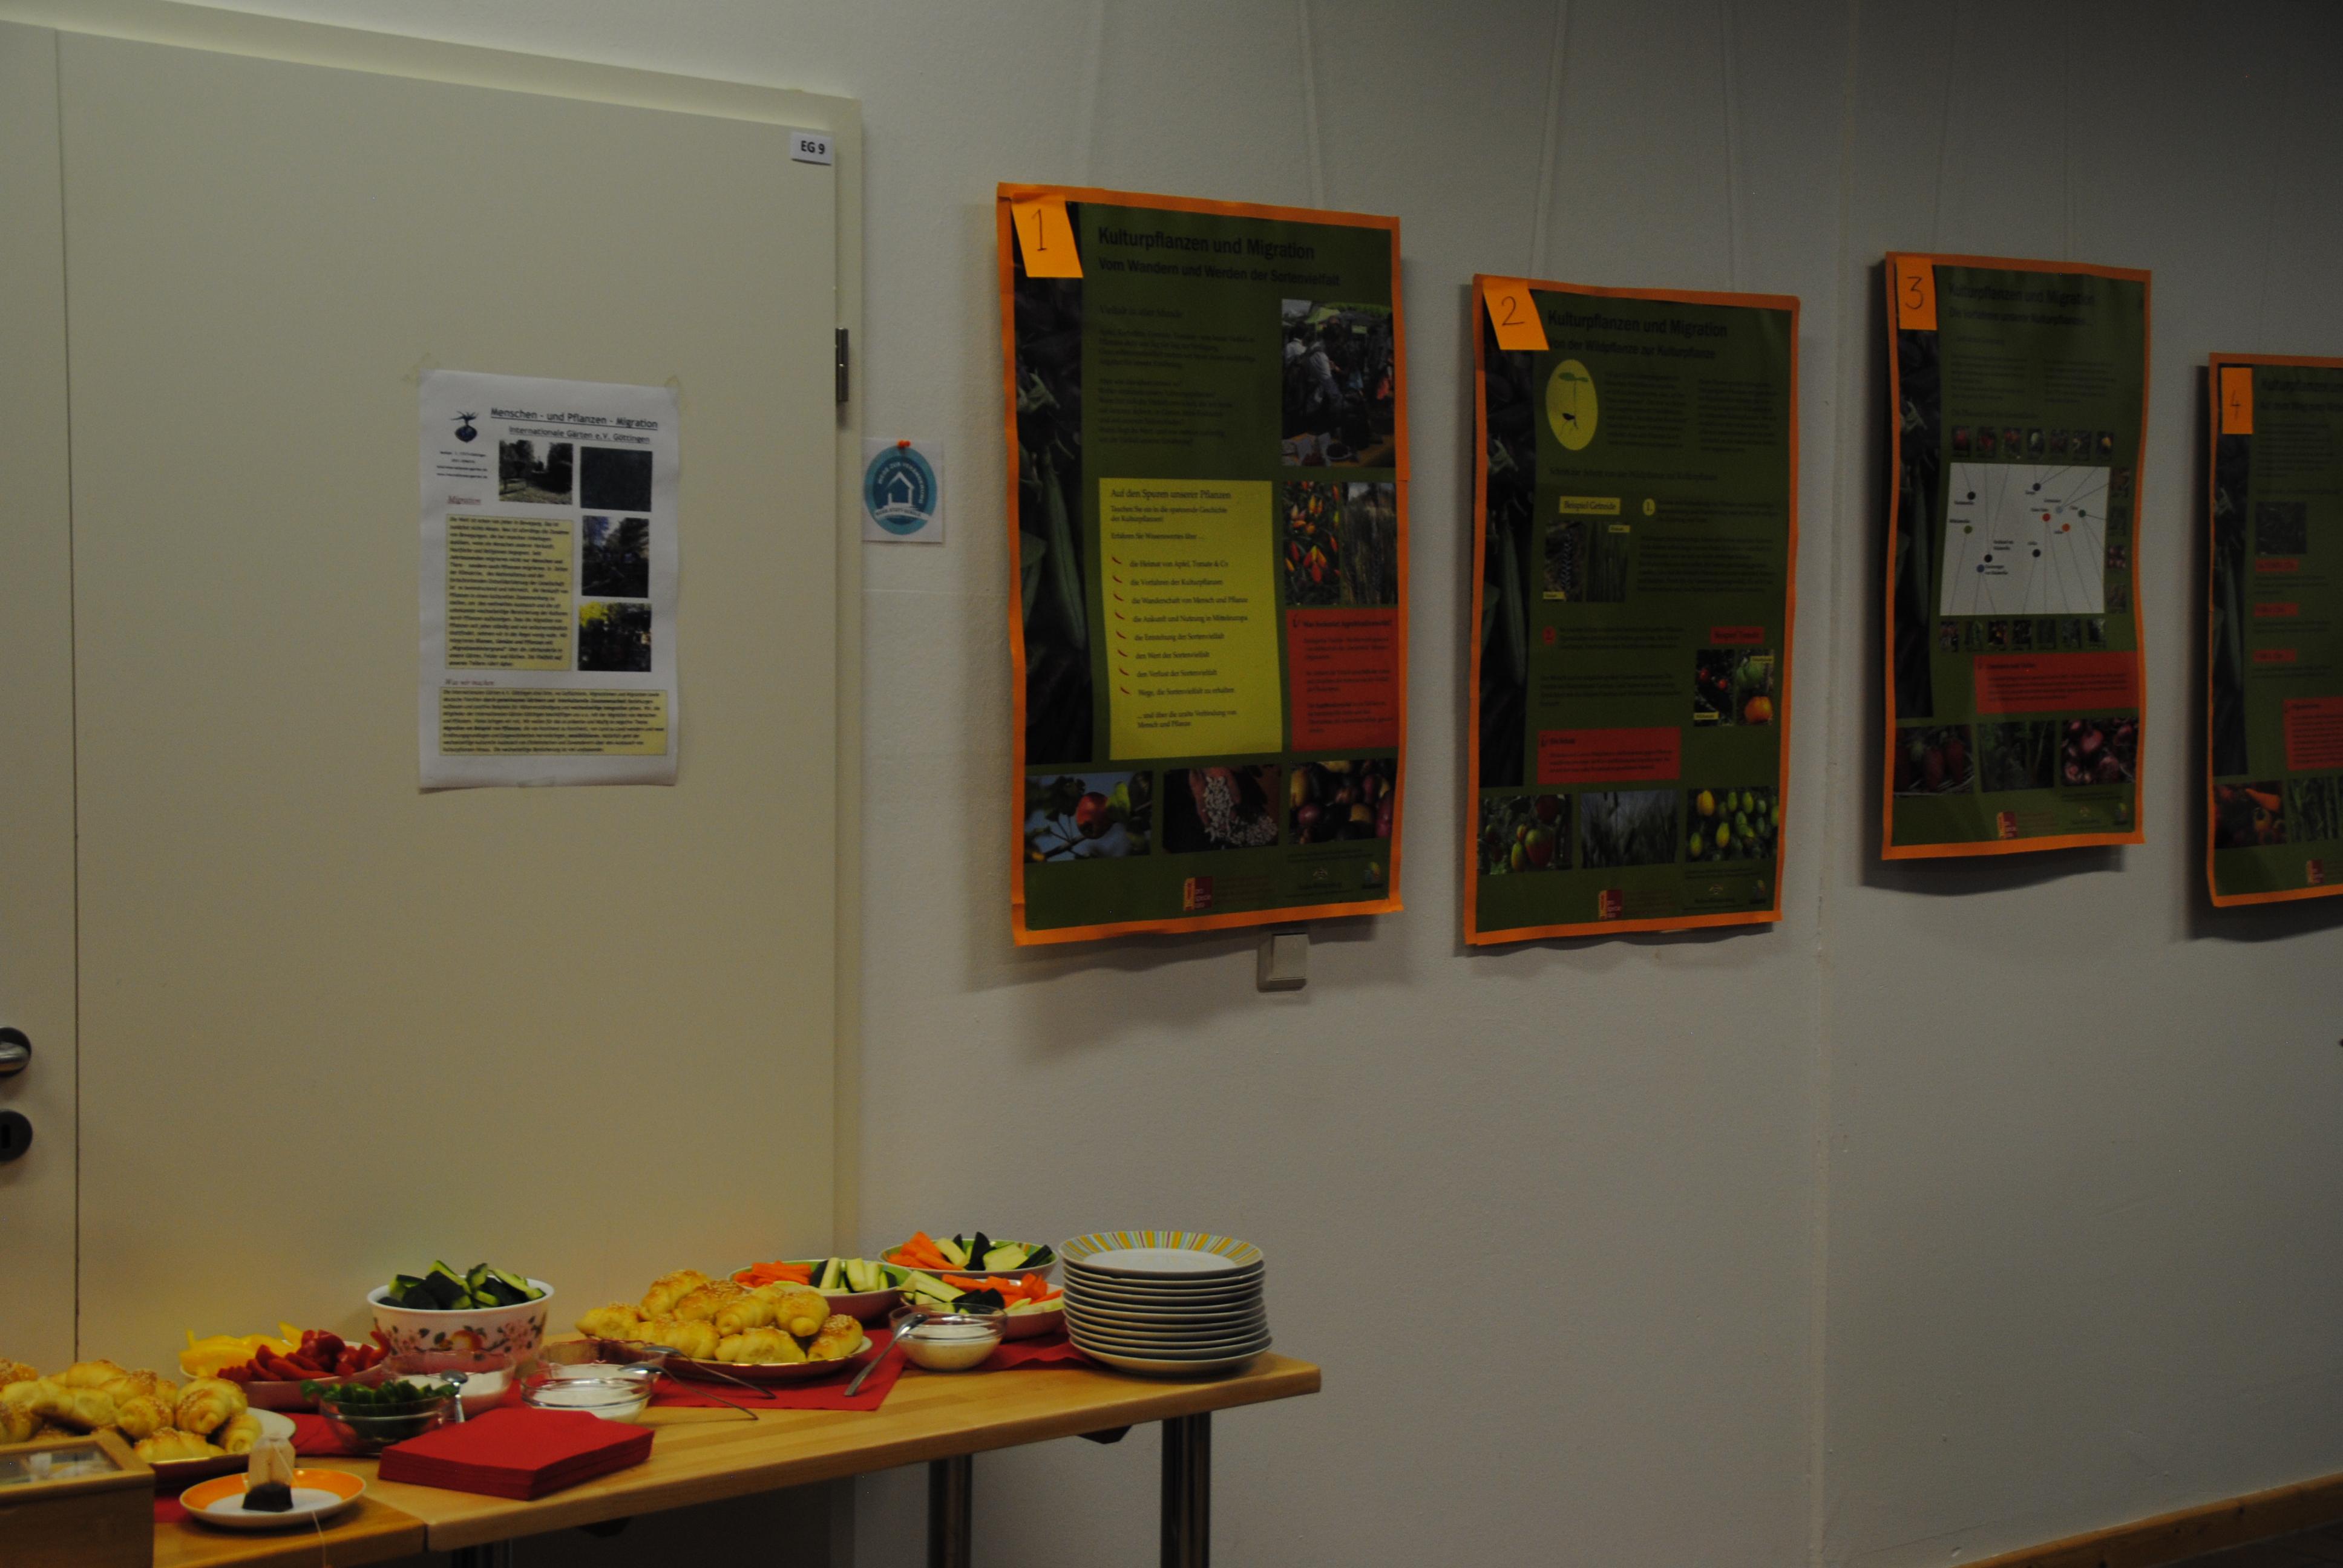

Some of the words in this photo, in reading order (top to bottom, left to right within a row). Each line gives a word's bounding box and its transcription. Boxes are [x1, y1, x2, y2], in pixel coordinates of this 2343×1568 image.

[801, 140, 816, 153] EG
[818, 143, 825, 155] 9
[1031, 207, 1047, 251] 1
[1098, 227, 1210, 252] Kulturpflanzen
[1213, 238, 1243, 255] und
[1247, 238, 1316, 260] Migration
[1099, 258, 1124, 271] Vom
[1127, 259, 1179, 275] Wandern
[1182, 263, 1202, 277] und
[1205, 265, 1247, 281] Werden
[1251, 269, 1268, 282] der
[1271, 270, 1341, 287] Sortenvielfalt
[1904, 276, 1924, 310] 3
[1501, 295, 1525, 327] 2
[1548, 310, 1640, 331] Kulturpflanzen
[1644, 319, 1667, 333] und
[1670, 319, 1728, 338] Migration
[1585, 340, 1639, 355] Wildpflanze
[491, 408, 537, 419] Menschen
[547, 413, 565, 422] und
[568, 413, 606, 424] Pflanzen
[616, 417, 658, 428] Migration
[509, 426, 564, 437] Internationale
[566, 430, 593, 439] Gärten
[613, 433, 650, 444] Göttingen
[1112, 489, 1124, 497] Auf
[1126, 489, 1141, 498] den
[1142, 489, 1168, 501] Spuren
[1200, 489, 1232, 499] Pflanzen
